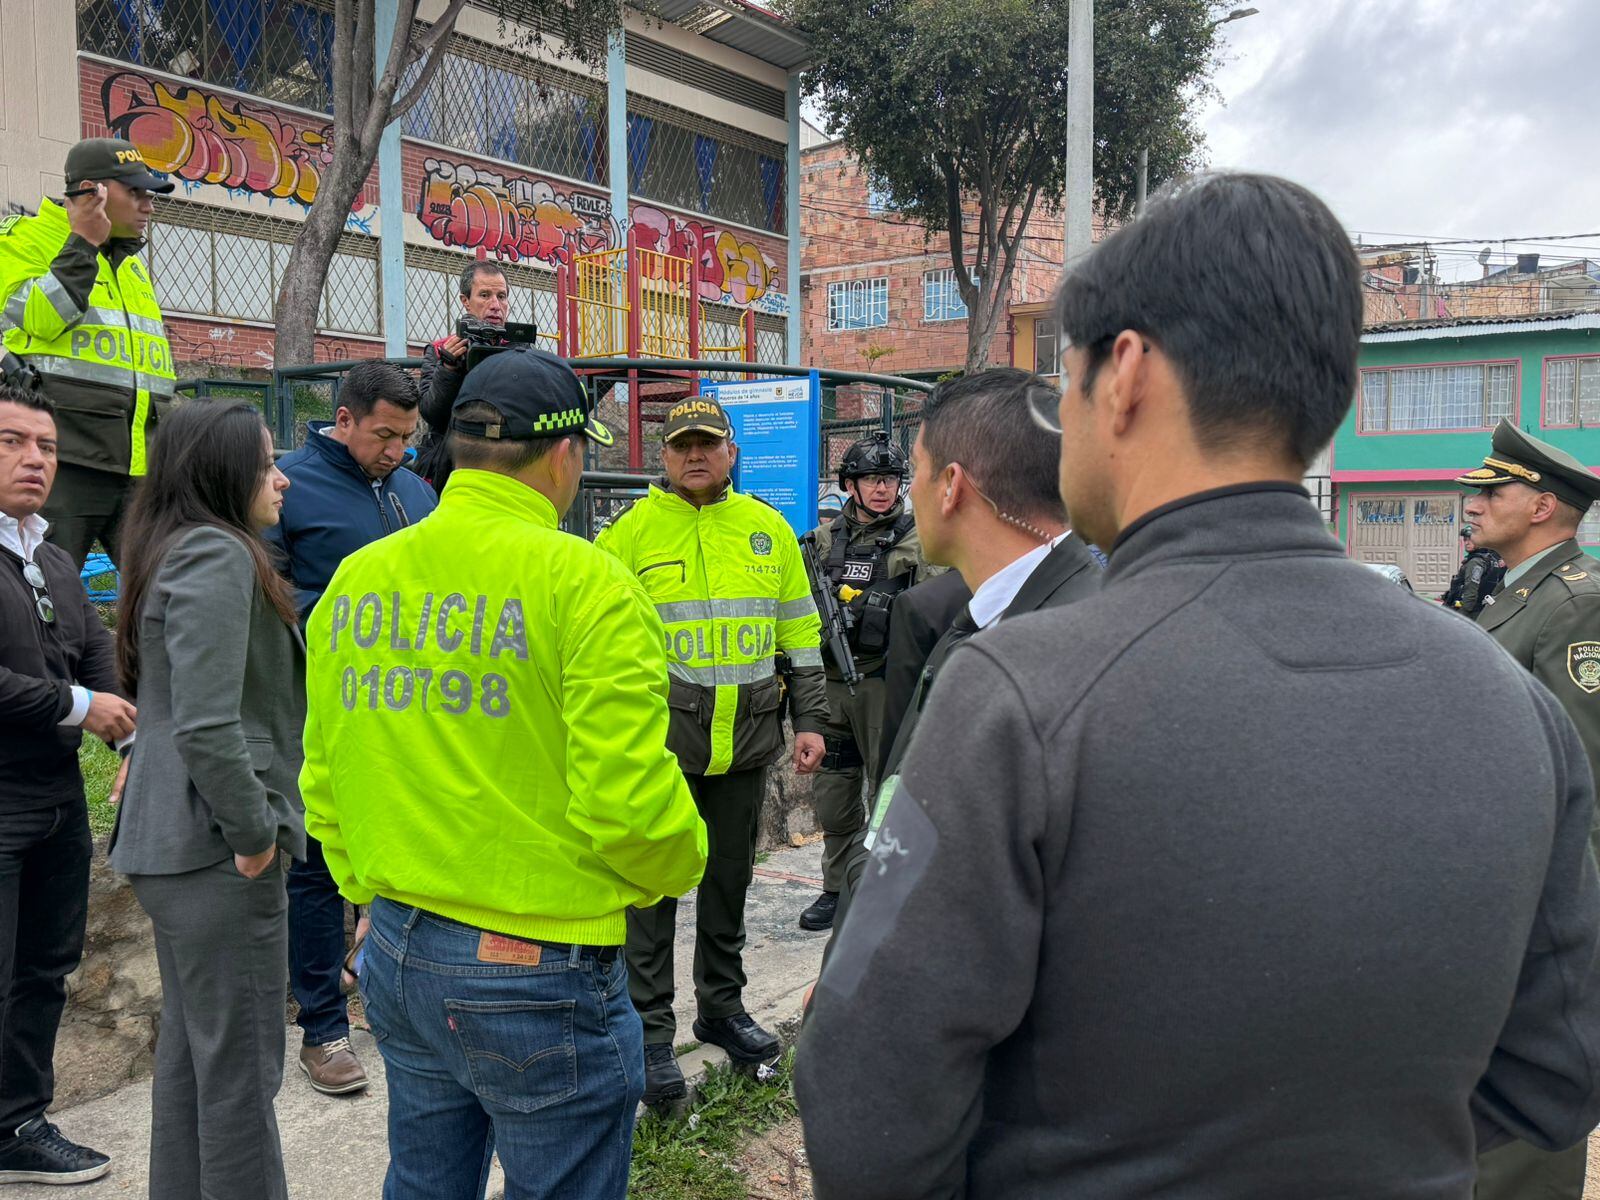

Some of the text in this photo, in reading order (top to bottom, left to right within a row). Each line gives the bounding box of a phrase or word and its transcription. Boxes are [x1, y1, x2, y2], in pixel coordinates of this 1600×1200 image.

[669, 401, 720, 421] POLICIA
[330, 591, 529, 660] POLICIA
[341, 664, 511, 718] 010798
